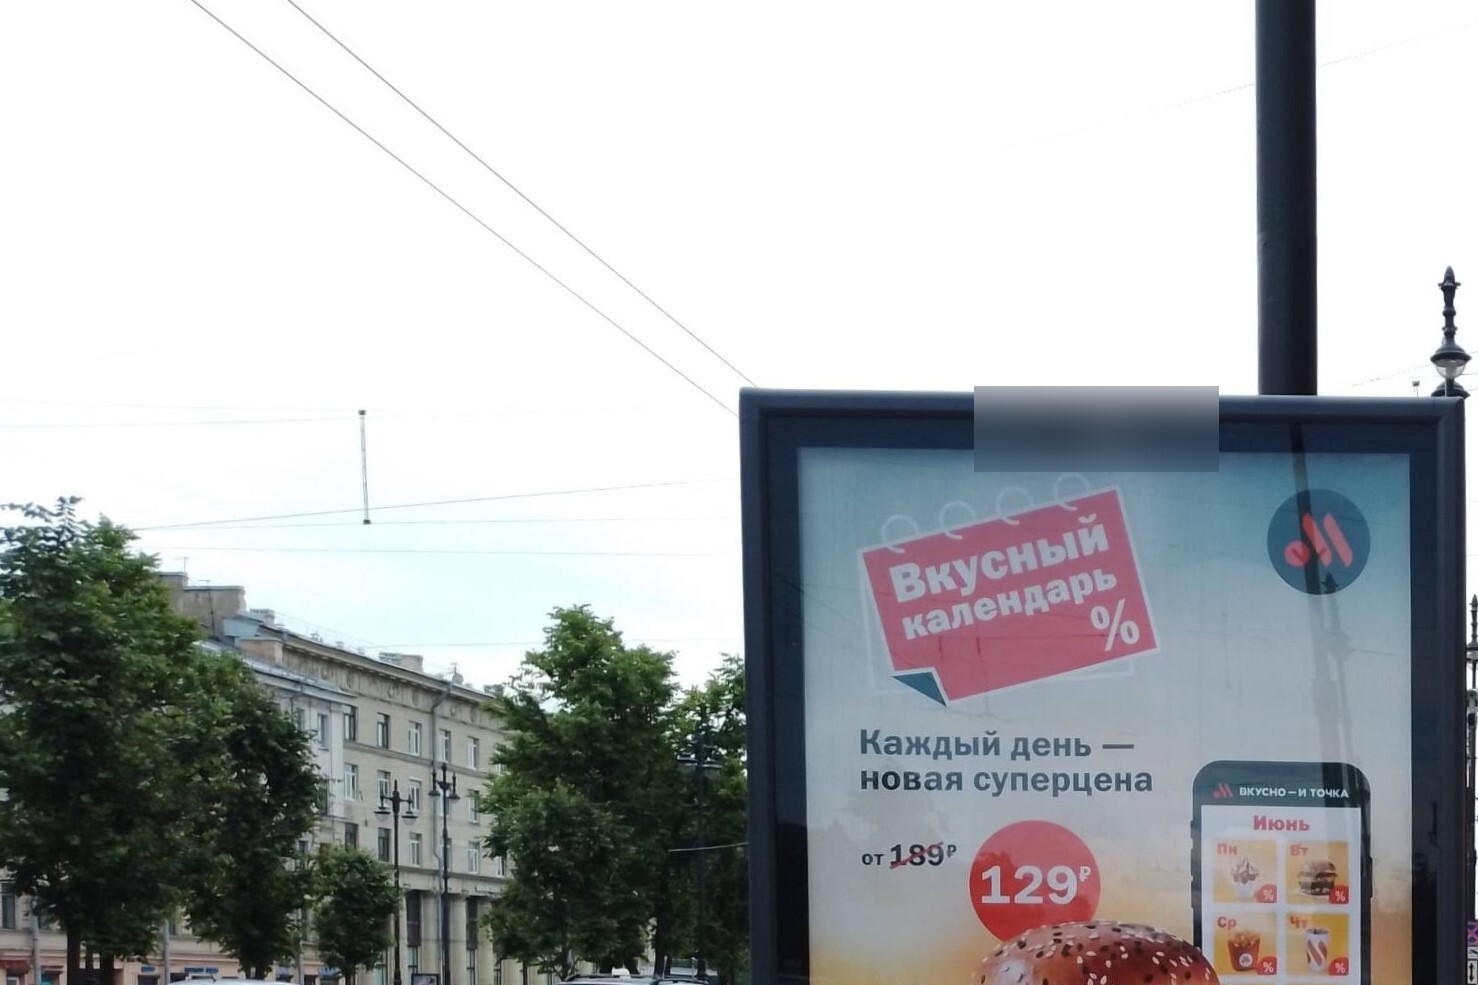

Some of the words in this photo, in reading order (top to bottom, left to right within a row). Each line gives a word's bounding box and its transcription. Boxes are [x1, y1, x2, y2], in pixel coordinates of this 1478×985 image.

[889, 513, 1110, 602] Вкусный
[902, 568, 1117, 640] календарь
[1090, 599, 1140, 651] %
[860, 729, 1000, 760] Каждый
[1011, 737, 1092, 760] день
[860, 770, 963, 791] новая
[973, 771, 1153, 797] суперцена
[1239, 787, 1286, 797] ВКУСНО
[1310, 788, 1349, 799] ТОЧКА
[1253, 815, 1310, 831] Июнь
[1217, 843, 1237, 855] Пн
[1290, 844, 1308, 856] Вт
[861, 853, 884, 866] от
[1217, 916, 1237, 929] Ср
[1290, 915, 1308, 928] Чт
[1263, 961, 1274, 973] %
[1335, 961, 1346, 973] %
